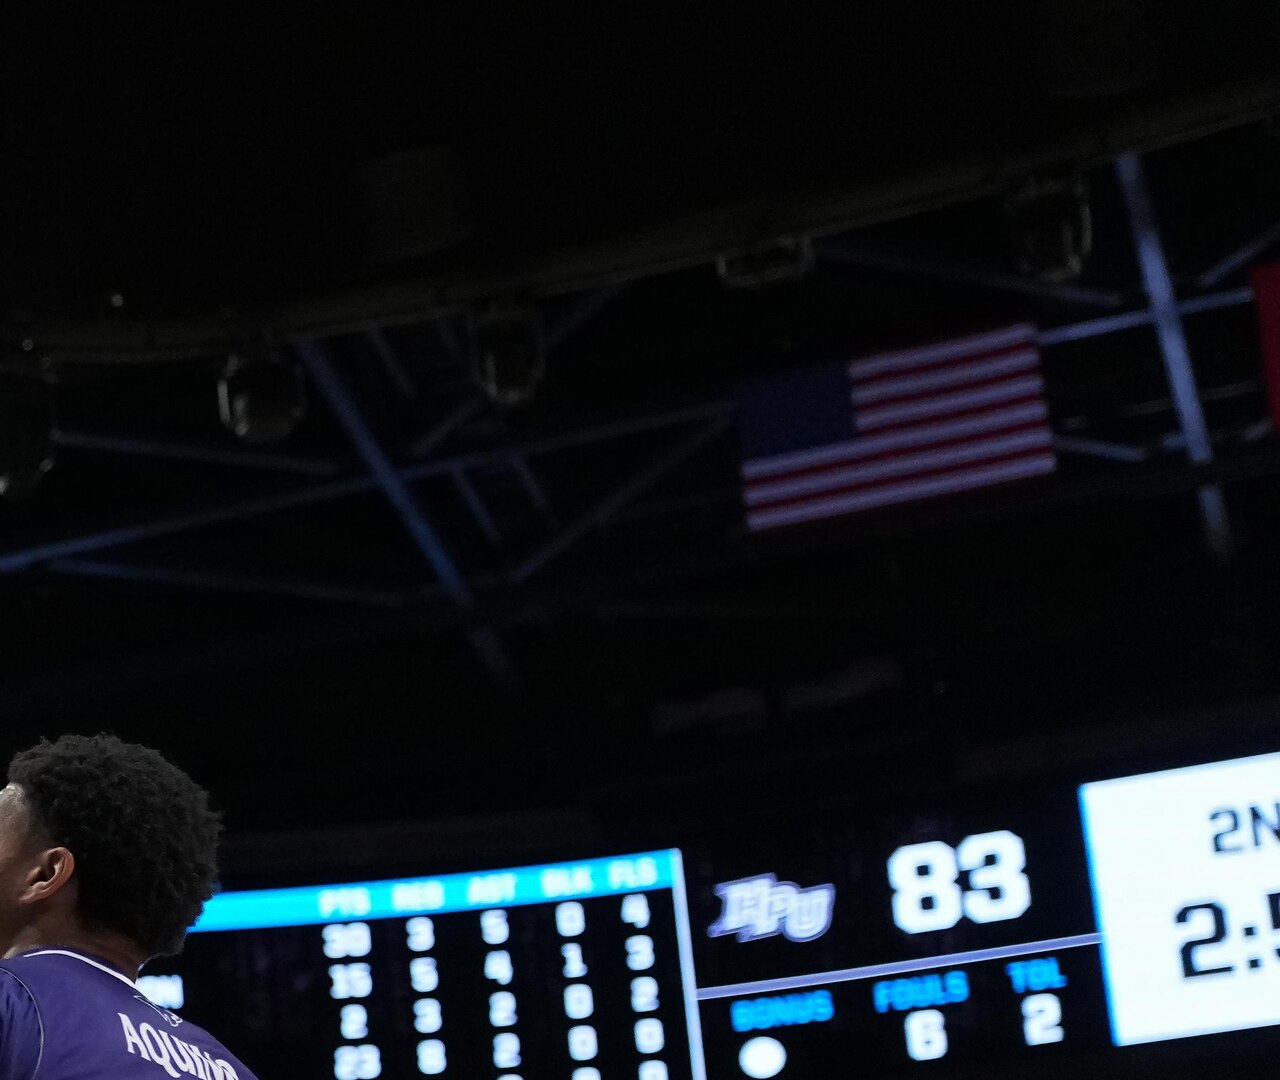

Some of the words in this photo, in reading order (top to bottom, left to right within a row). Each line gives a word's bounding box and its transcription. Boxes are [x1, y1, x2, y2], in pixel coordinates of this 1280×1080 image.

[887, 830, 1031, 934] 83
[406, 916, 435, 951] 3
[480, 908, 509, 944] 5
[555, 901, 585, 937] 0
[621, 893, 650, 928] 4
[329, 962, 372, 999] 15
[410, 957, 438, 993] 5
[484, 950, 513, 985] 4
[561, 942, 587, 978] 1
[625, 935, 655, 971] 3
[873, 971, 970, 1013] FOULS
[1006, 957, 1068, 993] TOL
[340, 1003, 368, 1039] 2
[413, 998, 442, 1034] 3
[490, 991, 517, 1027] 2
[564, 983, 594, 1019] 0
[631, 976, 659, 1012] 2
[730, 990, 835, 1032] BONUS
[904, 1009, 948, 1061] 6
[1021, 993, 1064, 1046] 2
[334, 1044, 381, 1080] 23
[493, 1032, 521, 1069] 2
[568, 1025, 598, 1061] 0
[634, 1017, 665, 1054] 0
